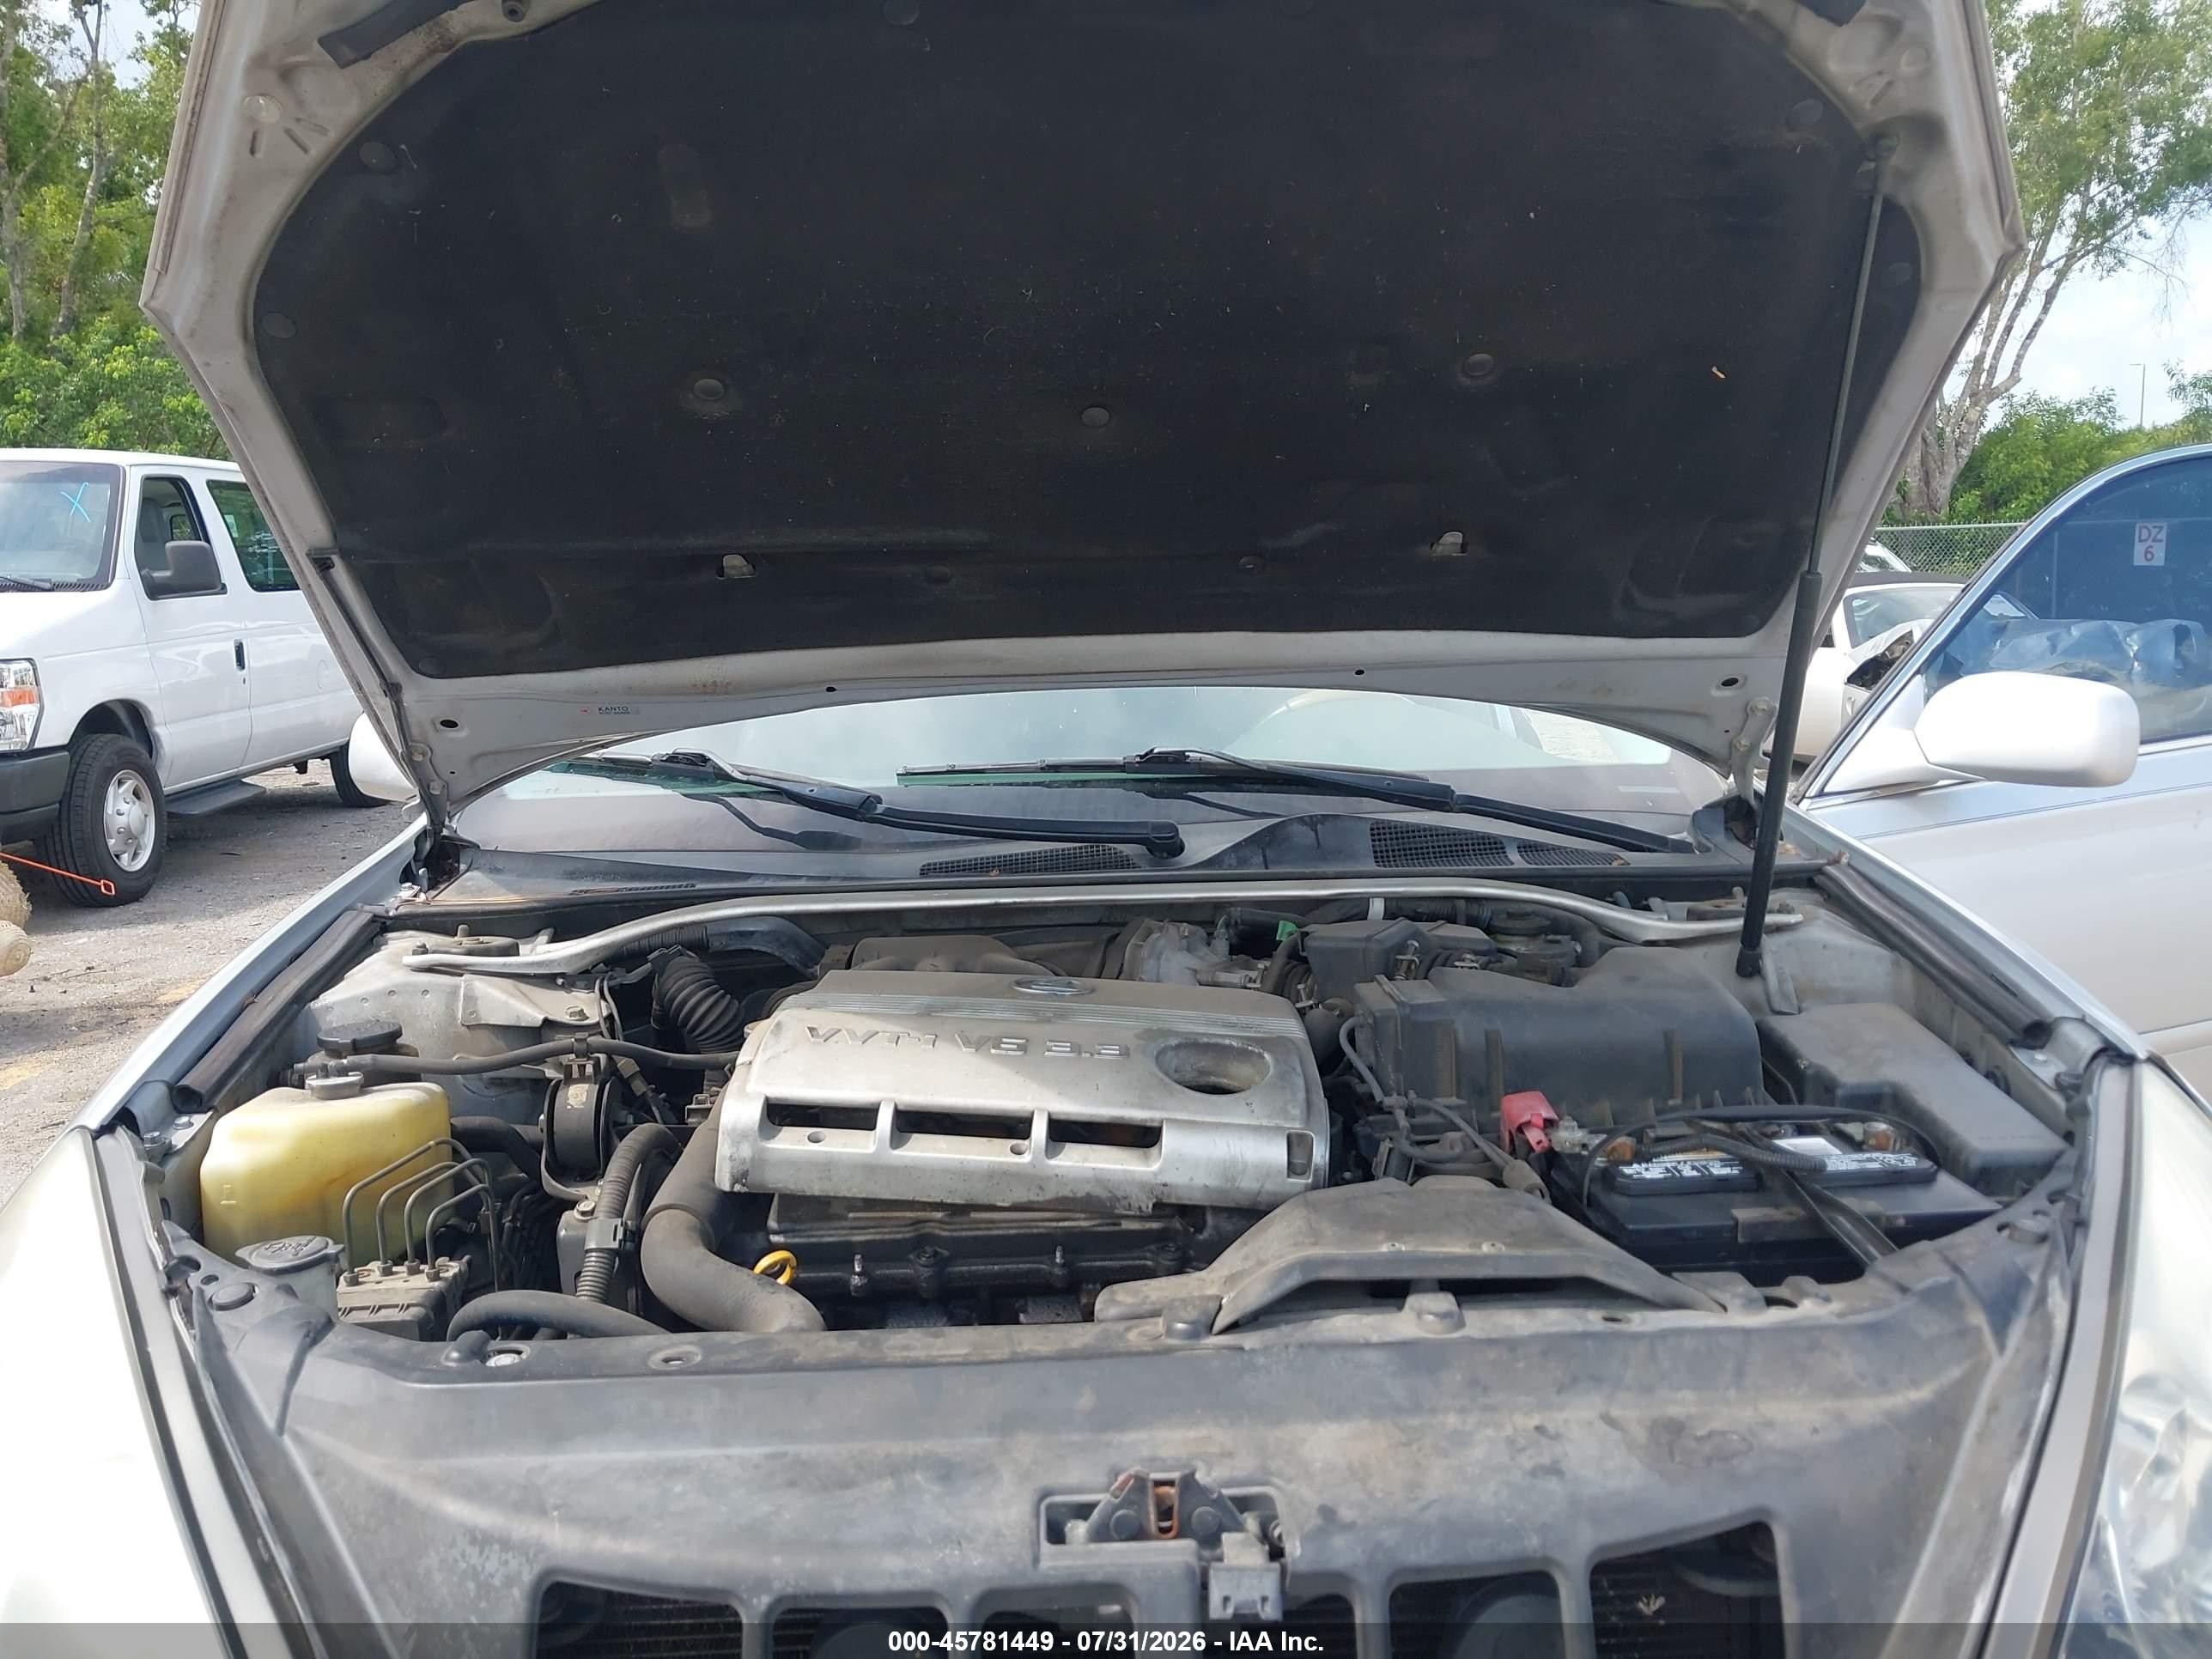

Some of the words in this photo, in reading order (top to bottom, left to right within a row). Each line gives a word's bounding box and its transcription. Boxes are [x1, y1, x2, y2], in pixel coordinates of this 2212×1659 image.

[2138, 525, 2165, 544] DZ
[2144, 544, 2154, 562] 6
[954, 1033, 1029, 1056] V6
[1043, 1040, 1131, 1060] 3.3
